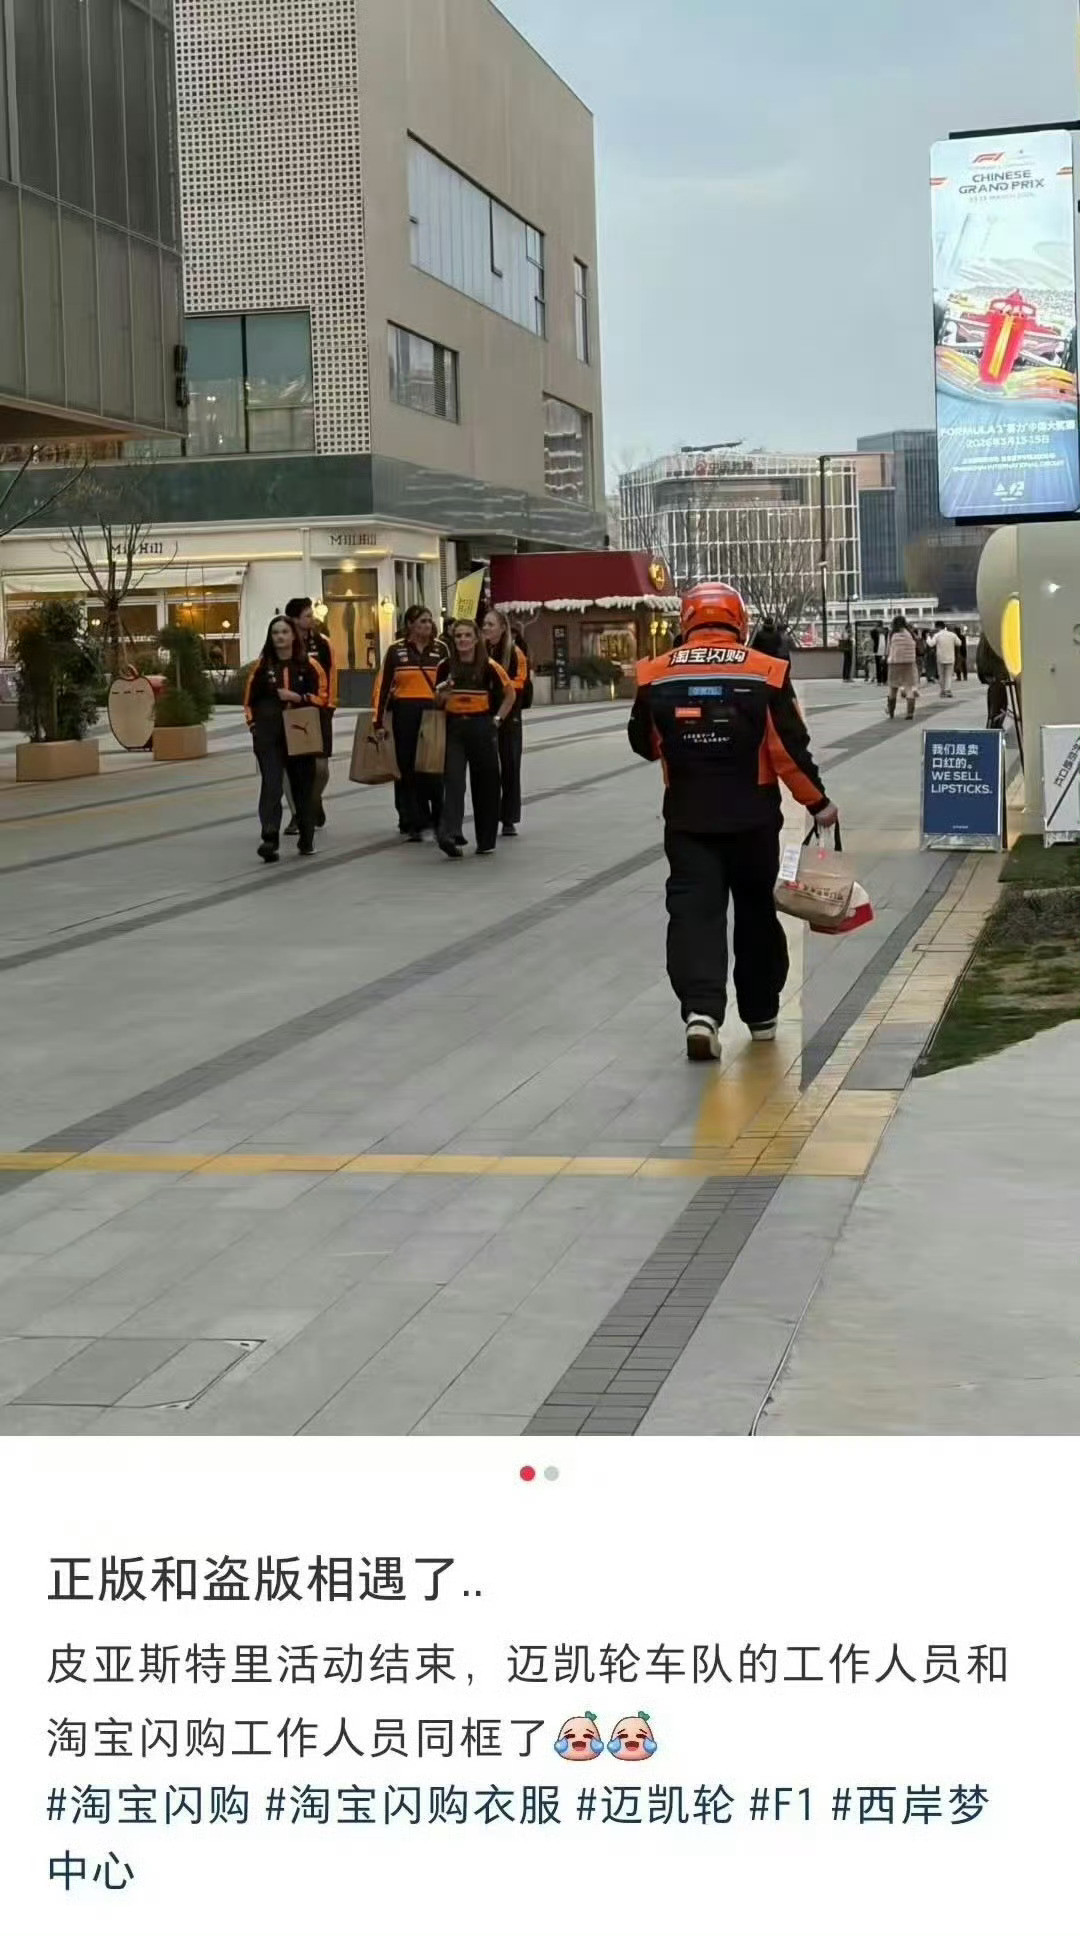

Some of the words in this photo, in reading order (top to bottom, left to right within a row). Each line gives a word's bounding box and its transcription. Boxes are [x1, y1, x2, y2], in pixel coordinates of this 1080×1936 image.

[972, 170, 1032, 183] CHINESE
[959, 182, 1009, 194] GRAND
[1011, 178, 1045, 191] PRIX
[138, 541, 163, 554] Hill
[671, 647, 746, 665] 淘宝闪购
[932, 744, 979, 756] 我们是卖
[932, 757, 973, 769] 口红的。
[931, 771, 951, 781] WE
[953, 771, 982, 781] SELL
[931, 784, 993, 794] LIPSTICKS.
